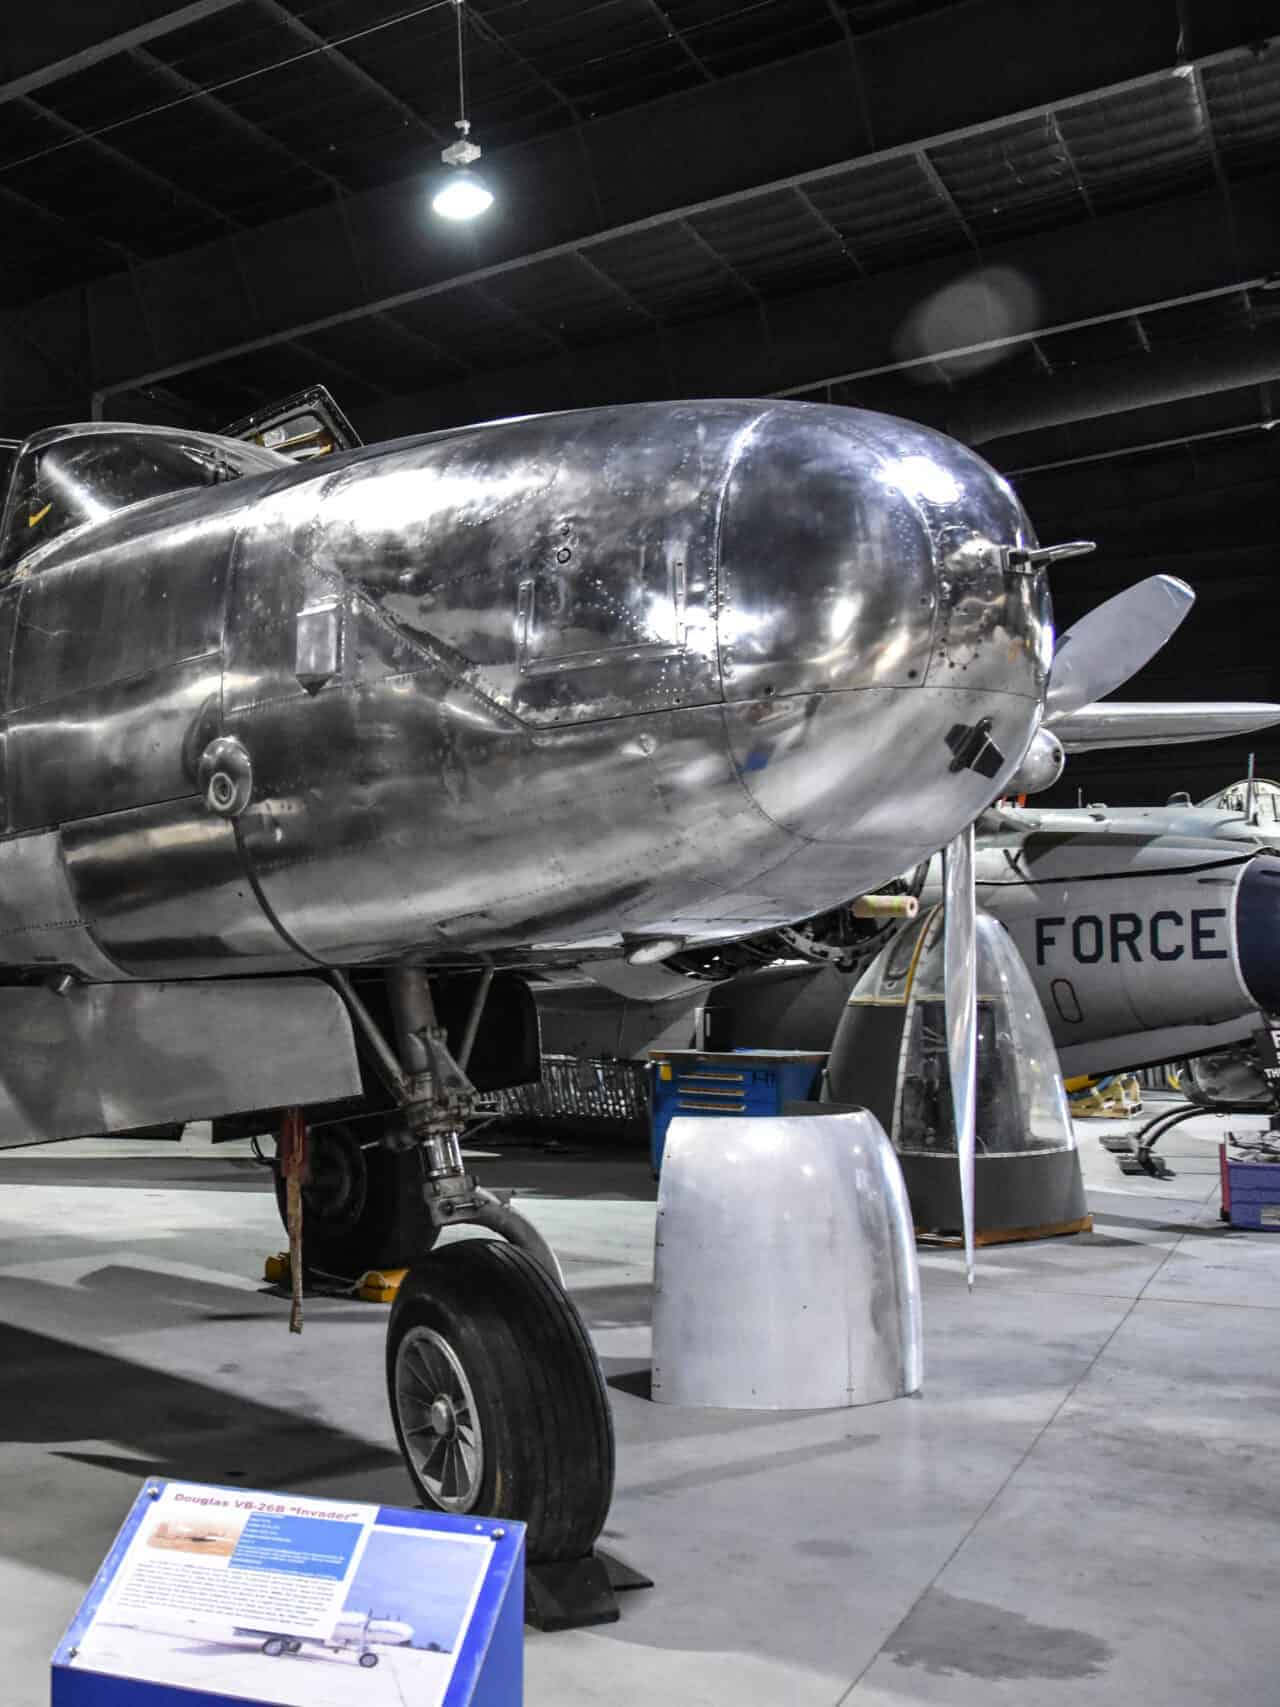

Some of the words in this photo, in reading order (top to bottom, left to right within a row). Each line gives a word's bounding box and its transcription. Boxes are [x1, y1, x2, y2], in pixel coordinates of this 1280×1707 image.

[1035, 908, 1228, 965] FORCE
[1264, 1068, 1280, 1079] TH
[174, 1493, 230, 1507] Douglas
[235, 1500, 286, 1513] VB-26B
